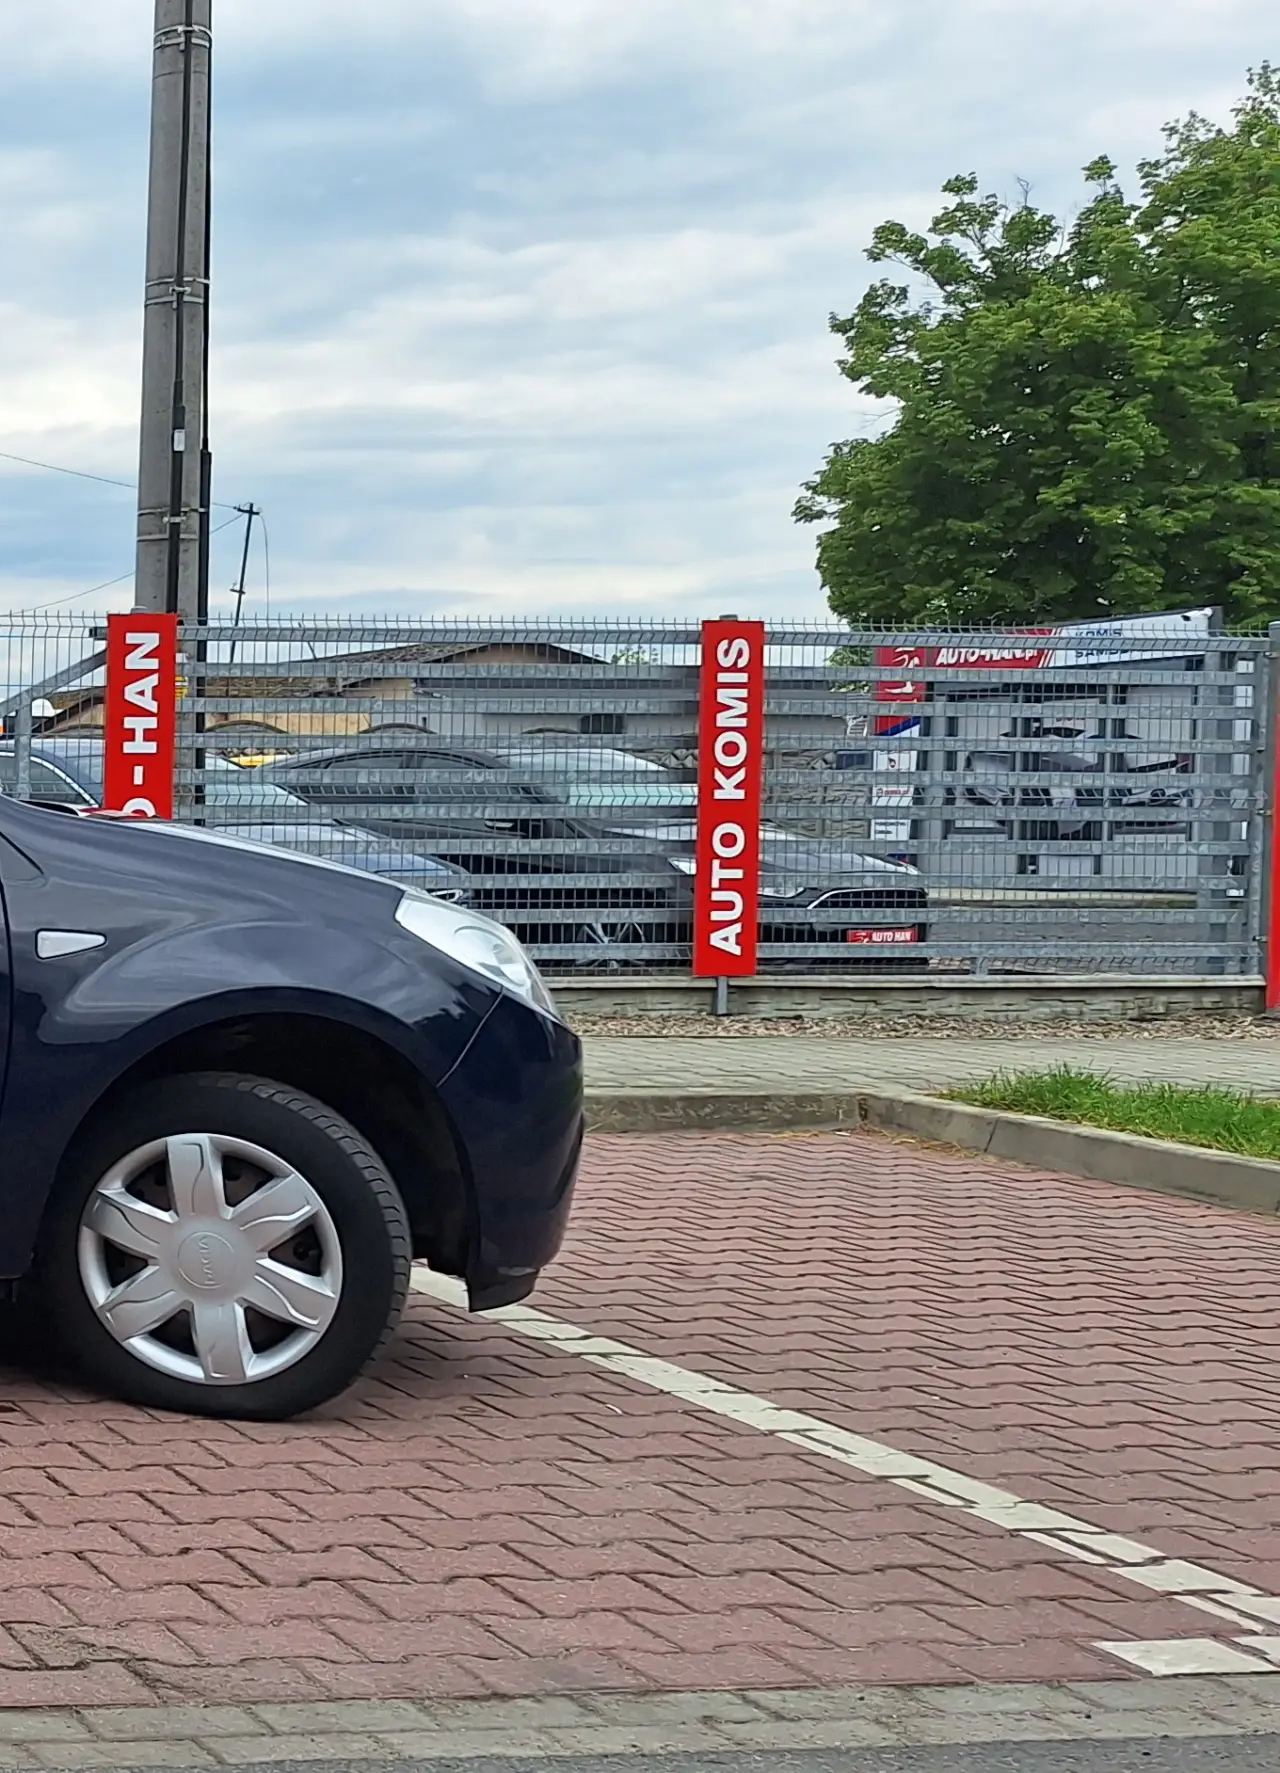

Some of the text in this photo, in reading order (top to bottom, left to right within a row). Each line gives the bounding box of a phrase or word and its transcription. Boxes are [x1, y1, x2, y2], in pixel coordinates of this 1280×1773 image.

[709, 638, 750, 956] AUTO KOMIS
[871, 931, 893, 942] AUTO
